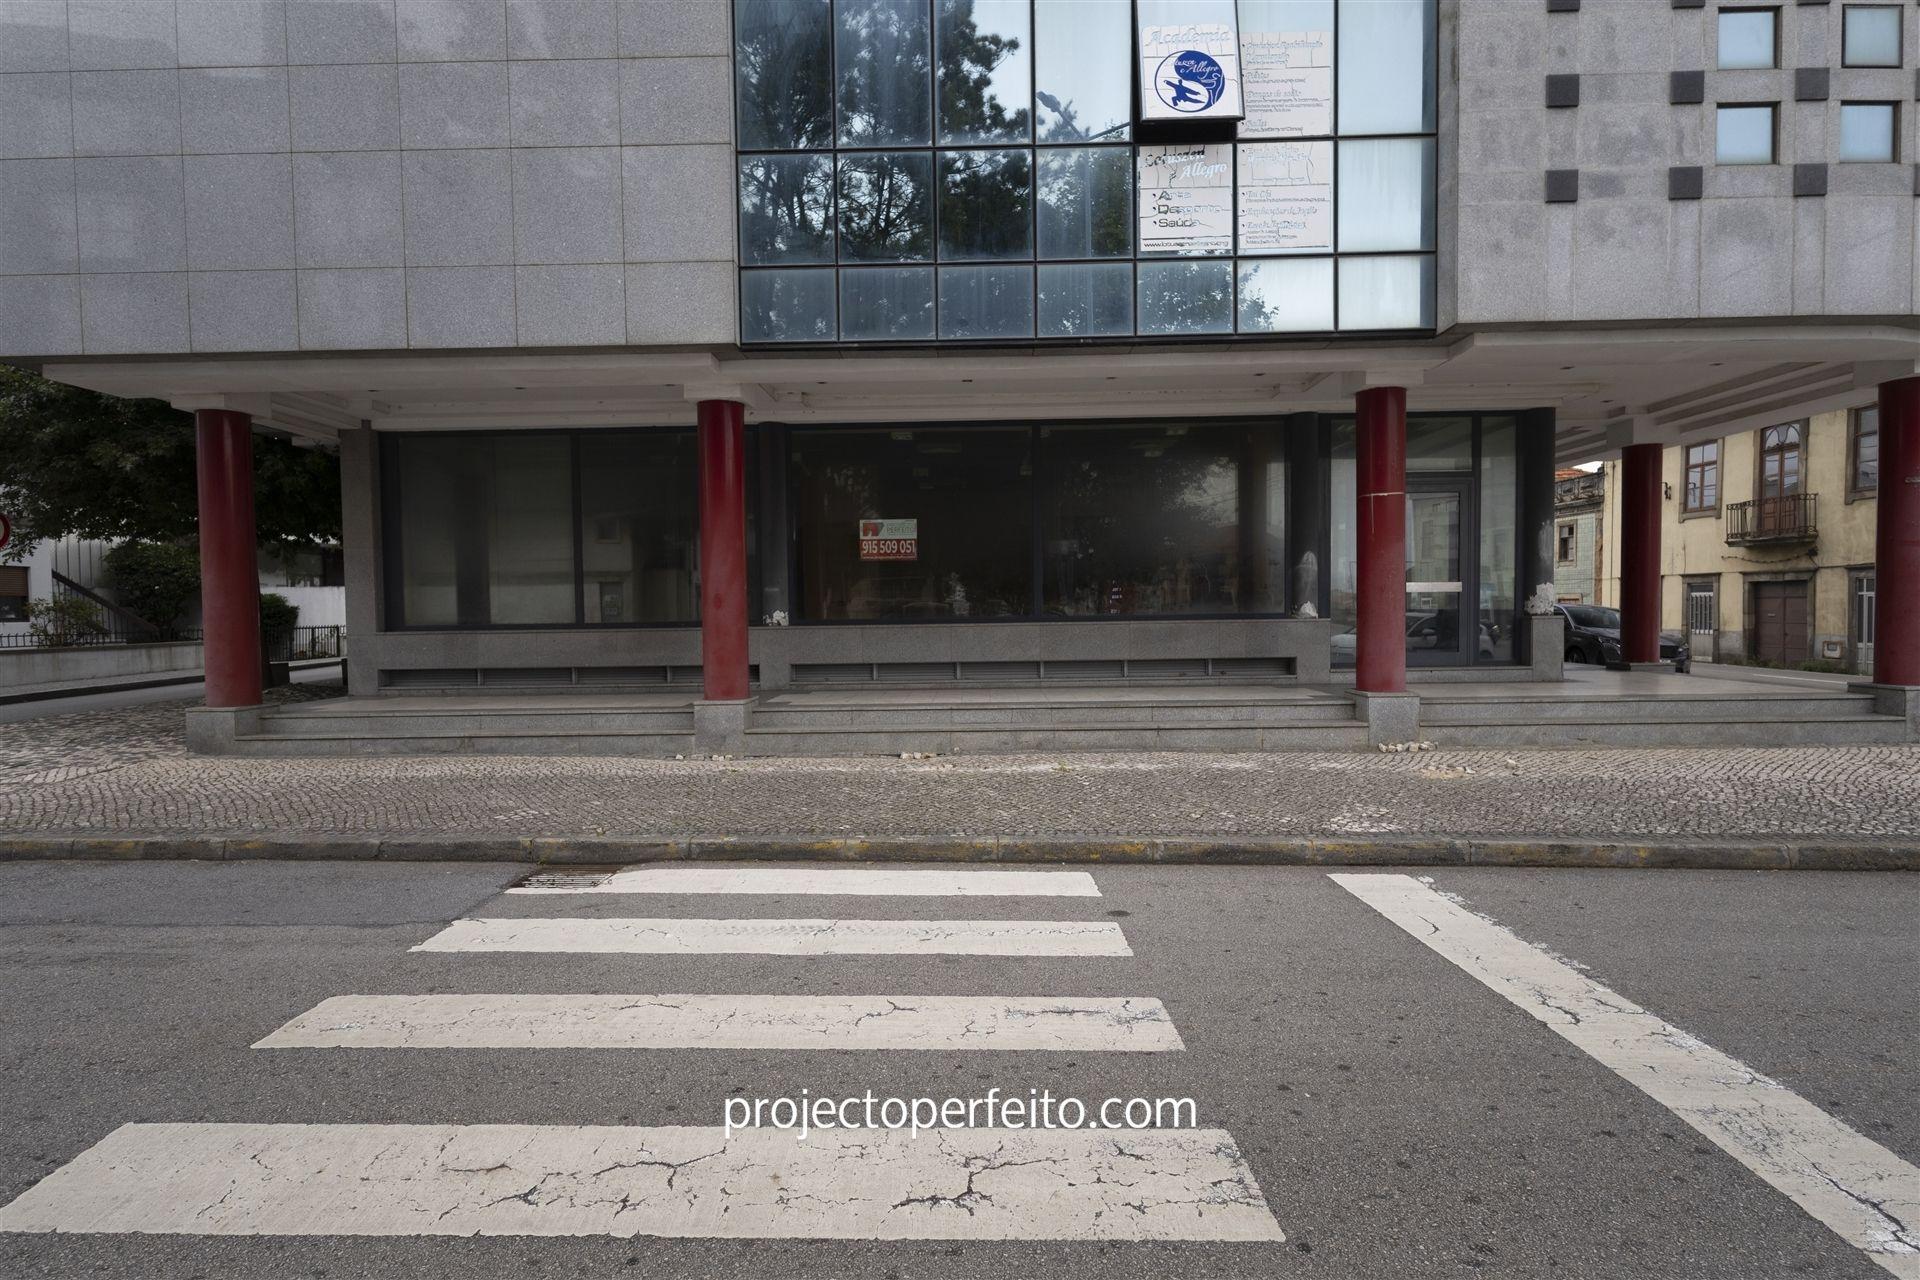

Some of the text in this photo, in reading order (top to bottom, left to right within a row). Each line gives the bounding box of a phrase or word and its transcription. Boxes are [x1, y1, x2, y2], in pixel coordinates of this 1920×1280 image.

[1186, 60, 1219, 78] Allegro
[1178, 161, 1228, 180] Allegro
[862, 540, 915, 553] 915 509 051
